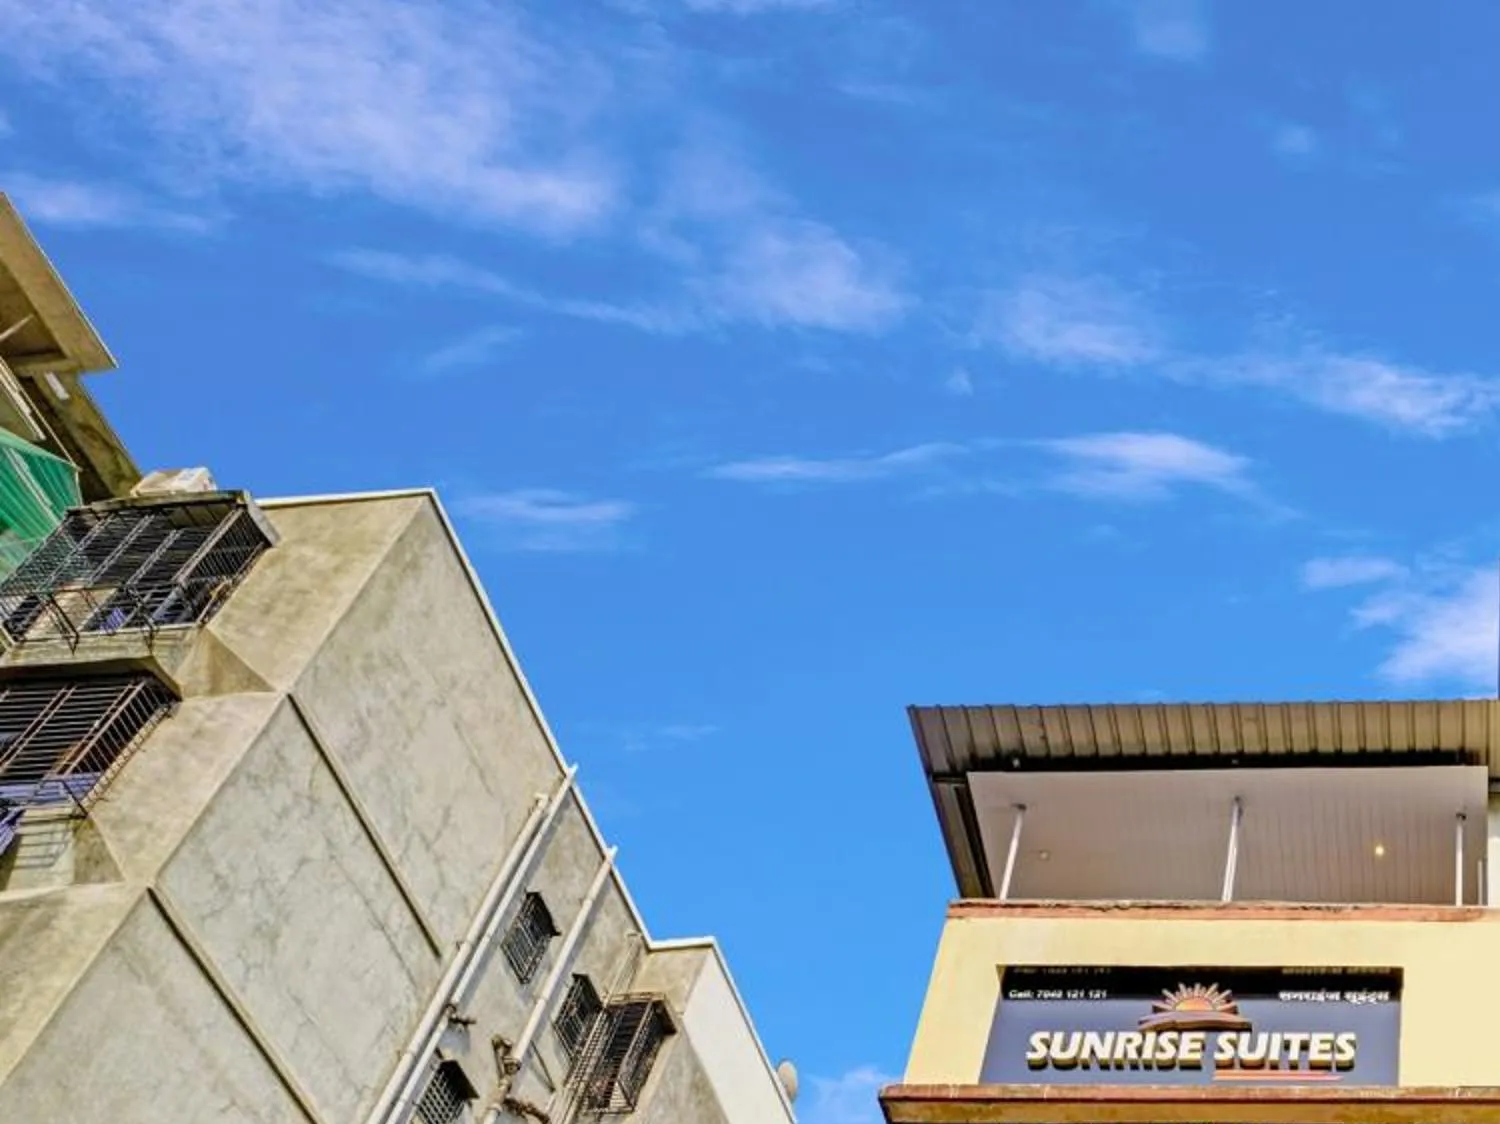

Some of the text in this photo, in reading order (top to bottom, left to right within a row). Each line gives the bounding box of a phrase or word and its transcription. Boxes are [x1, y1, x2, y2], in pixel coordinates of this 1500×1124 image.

[1009, 989, 1034, 999] Call:
[1026, 1031, 1357, 1069] SUNRISE SUITES
